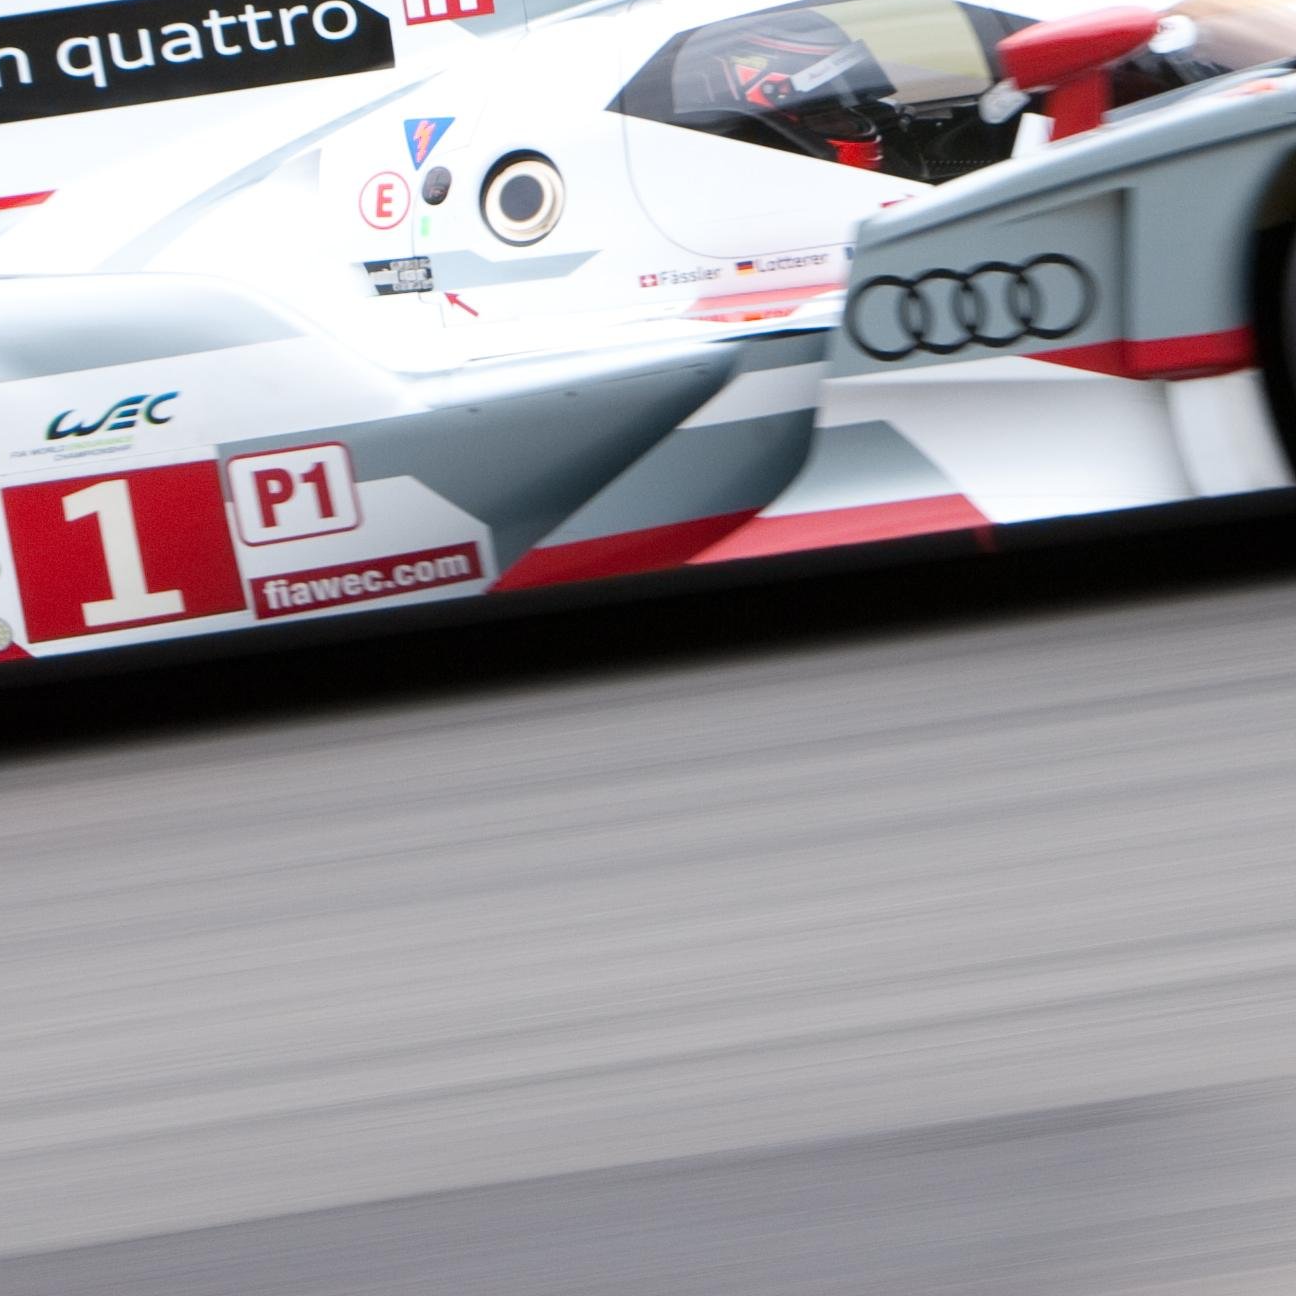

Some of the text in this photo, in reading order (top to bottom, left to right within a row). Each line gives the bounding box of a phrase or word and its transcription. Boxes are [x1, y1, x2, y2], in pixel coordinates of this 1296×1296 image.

[56, 0, 359, 88] quattro
[376, 183, 394, 218] E
[755, 253, 829, 275] Lotterer
[46, 391, 180, 441] WEC
[250, 461, 338, 529] P1
[61, 479, 187, 628] 1
[264, 551, 471, 610] fiawec.com
